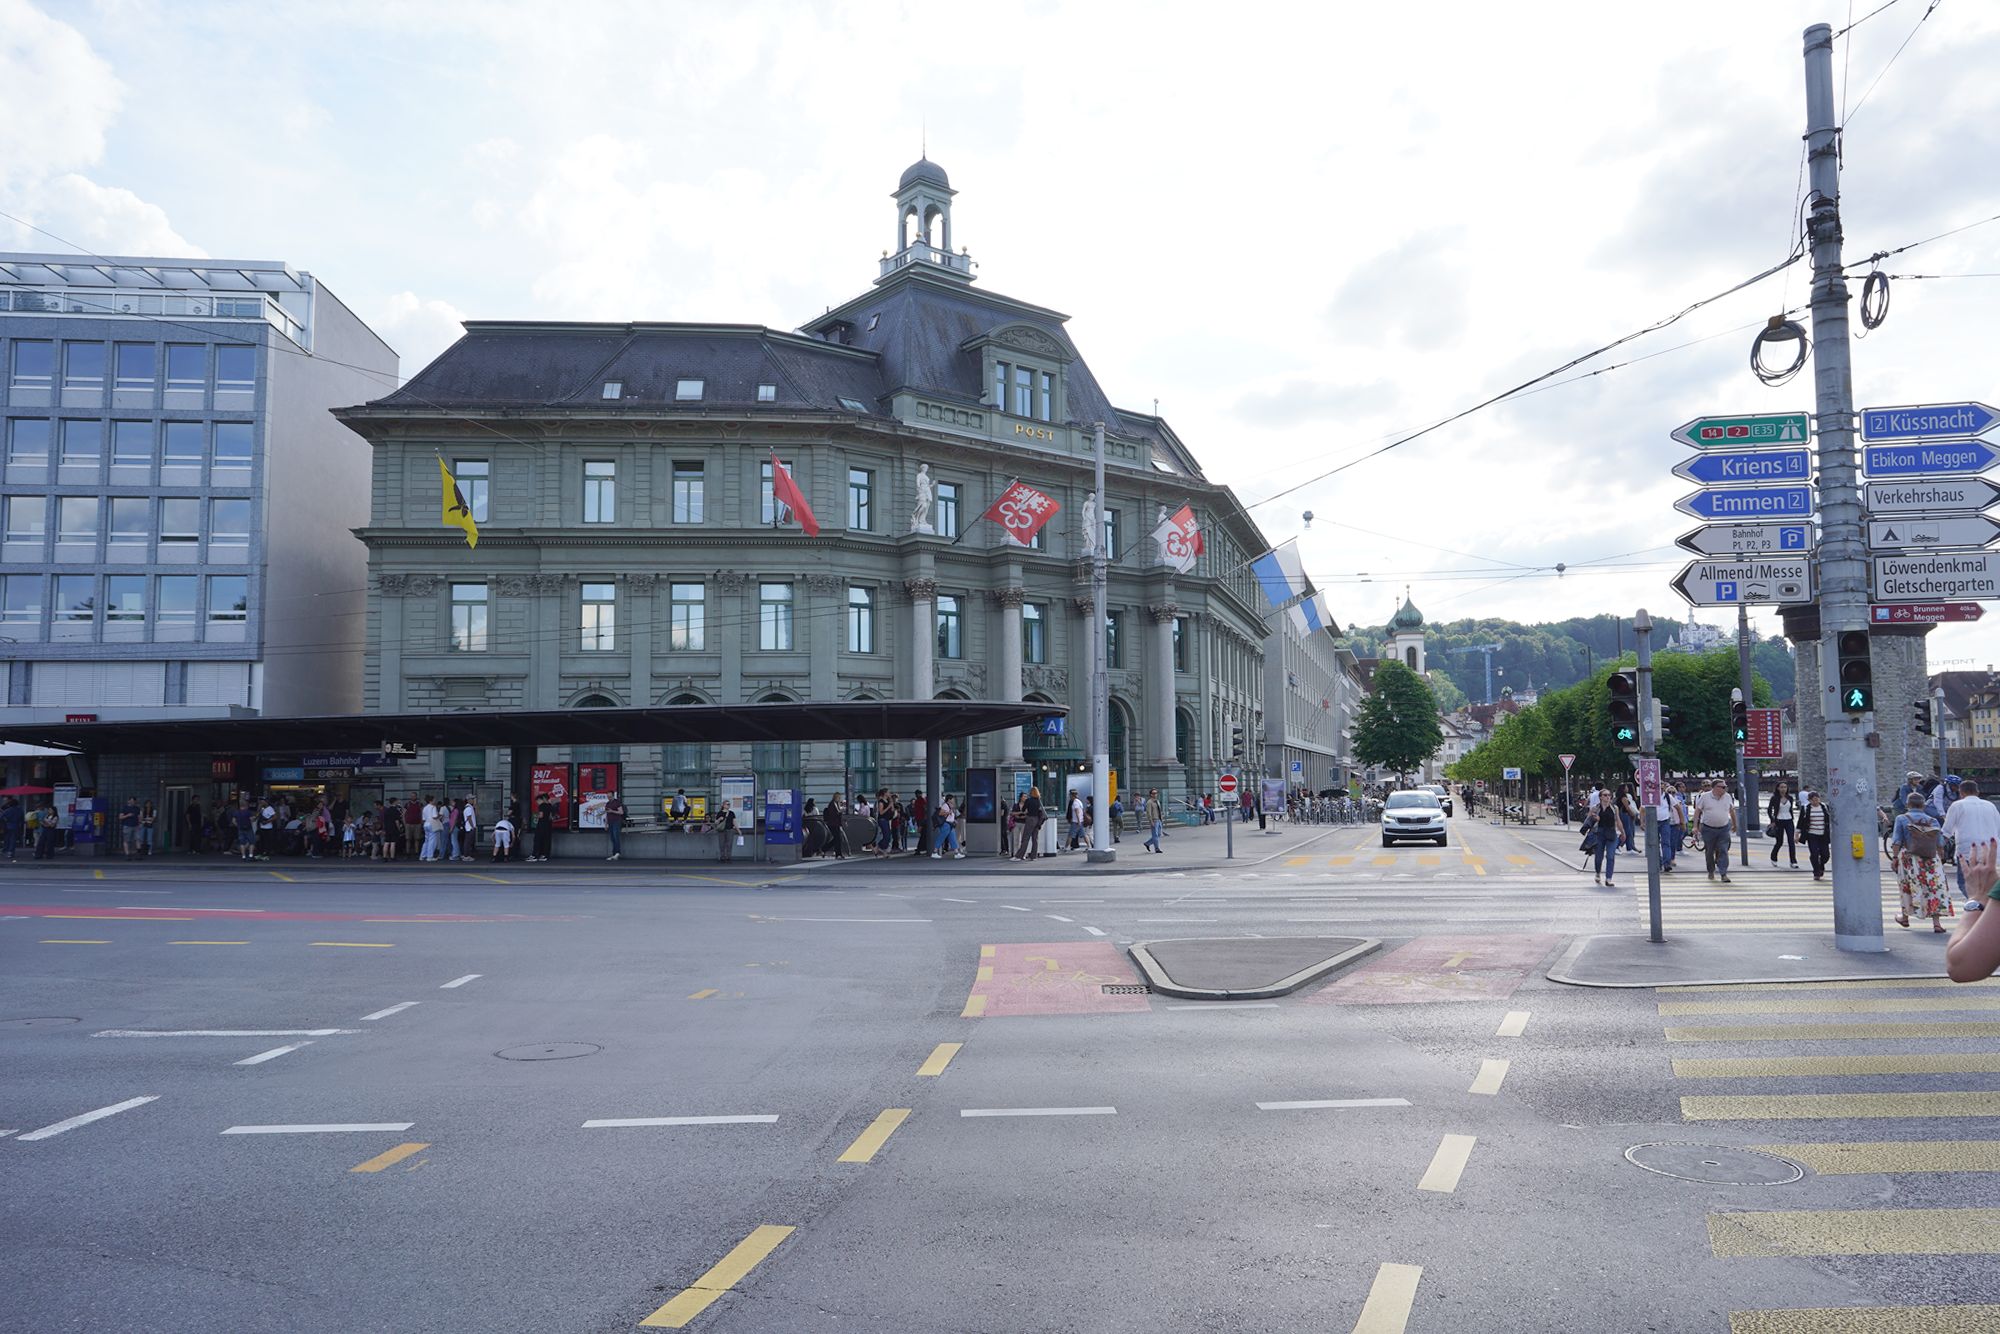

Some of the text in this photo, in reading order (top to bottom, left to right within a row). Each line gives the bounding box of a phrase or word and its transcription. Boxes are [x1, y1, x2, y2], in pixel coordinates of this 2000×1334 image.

[1875, 409, 1975, 432] 2 Küssnacht
[1015, 424, 1054, 441] POST
[1707, 429, 1717, 437] 14
[1735, 428, 1741, 436] 2
[1722, 457, 1799, 476] Kriens 4
[1872, 451, 1977, 468] Ebikon Meggen
[1712, 494, 1800, 512] Emmen 2
[1874, 487, 1964, 504] Verkehrshaus
[1732, 528, 1763, 538] Bahnhof
[1732, 540, 1771, 551] P1, P2, P3
[1700, 564, 1803, 580] Allmend/Messe
[1882, 556, 1987, 576] Löwendenkmal
[1883, 578, 1994, 596] Gletschergarten
[1913, 605, 1945, 613] Brunnen
[1913, 614, 1945, 622] Meggen
[1047, 719, 1057, 732] A
[303, 757, 361, 766] Luzern Bahnhof
[534, 769, 551, 779] 24/7
